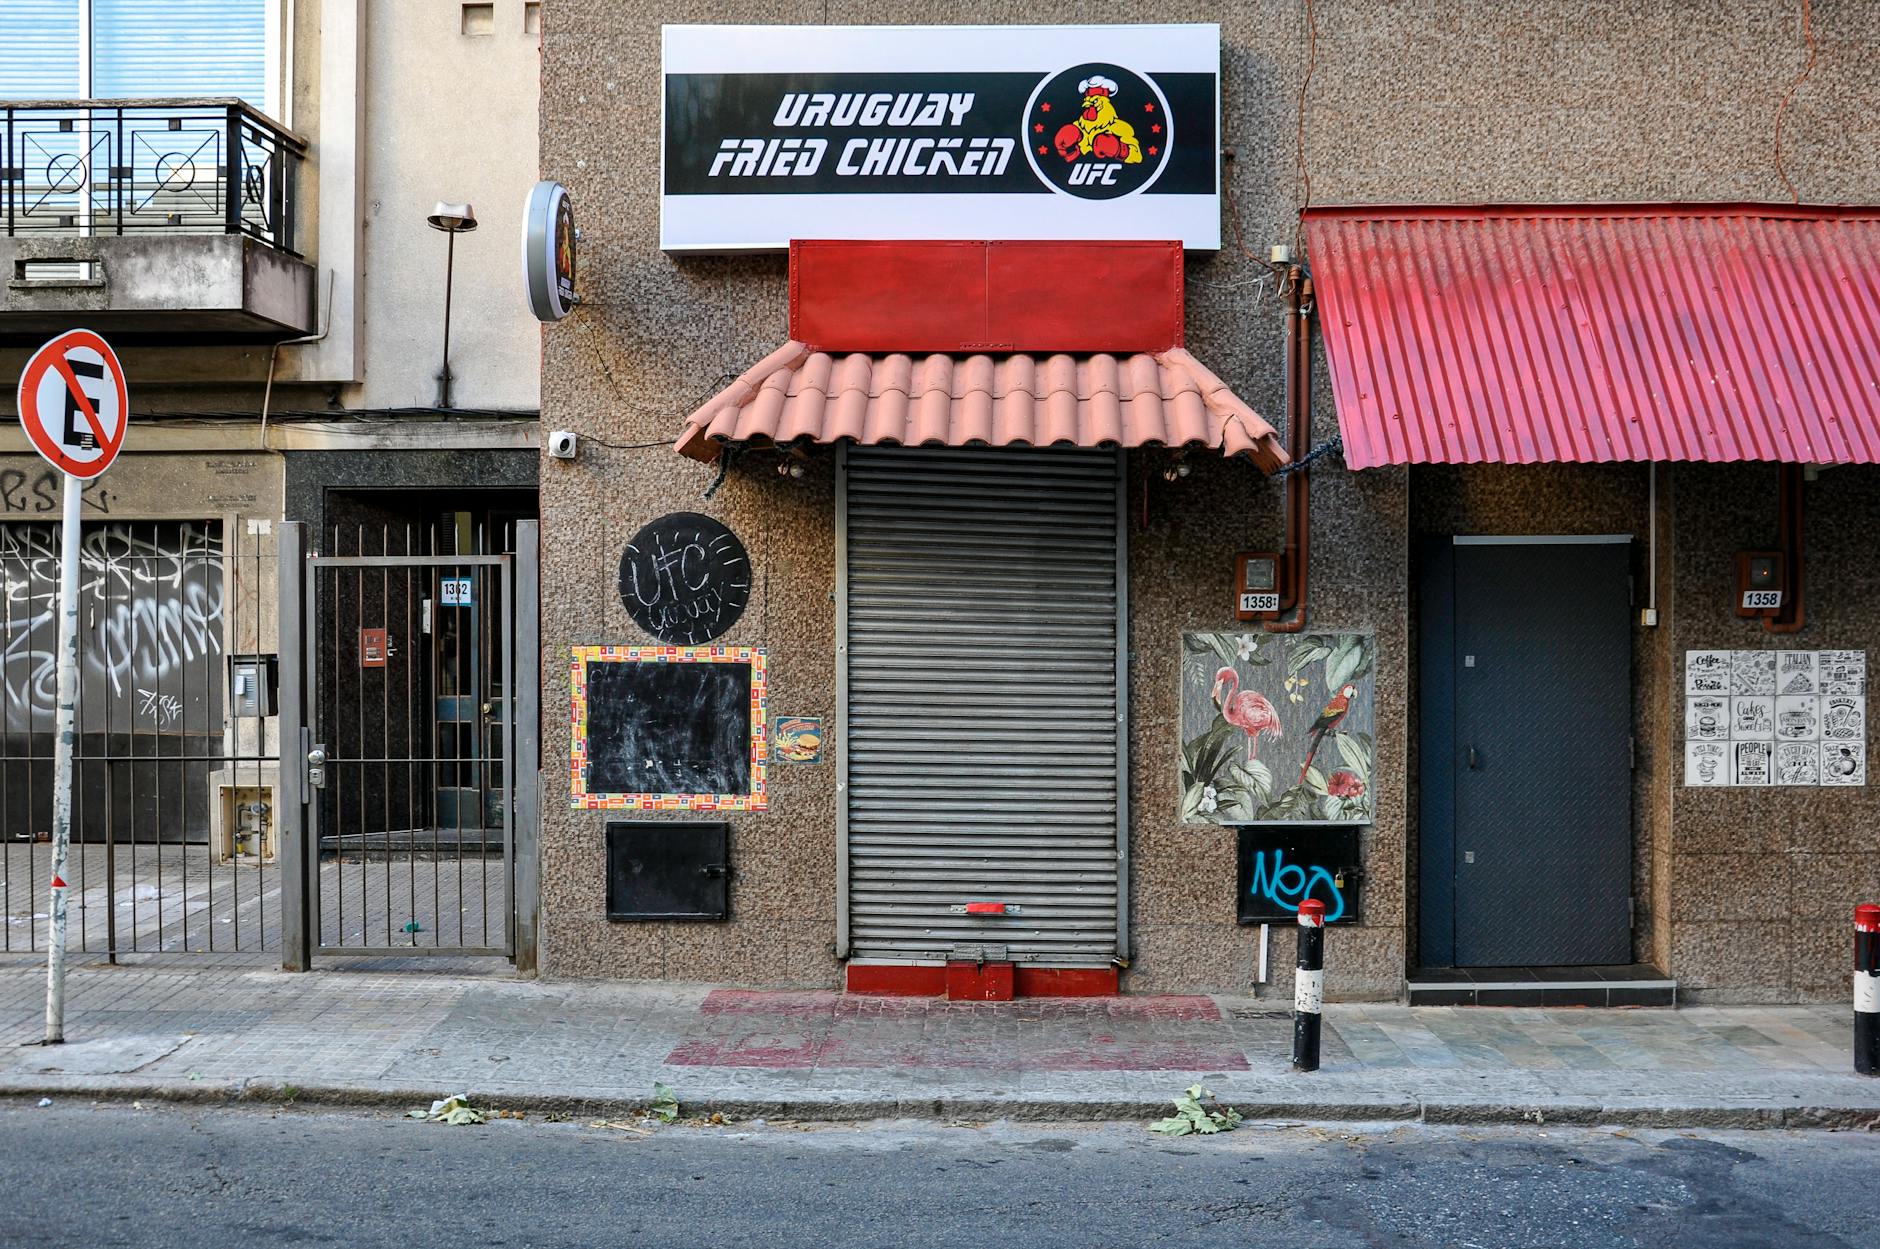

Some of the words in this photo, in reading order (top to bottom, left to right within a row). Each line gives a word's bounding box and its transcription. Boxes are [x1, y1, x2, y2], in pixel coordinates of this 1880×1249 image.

[773, 93, 975, 127] URUGUAY
[708, 138, 828, 176] FRIED
[836, 138, 1015, 176] CHICKEN
[1068, 163, 1123, 185] UFC
[630, 541, 709, 606] UFC
[1243, 596, 1273, 608] 1358
[1746, 593, 1778, 605] 1358
[1740, 742, 1766, 755] PEOPLE
